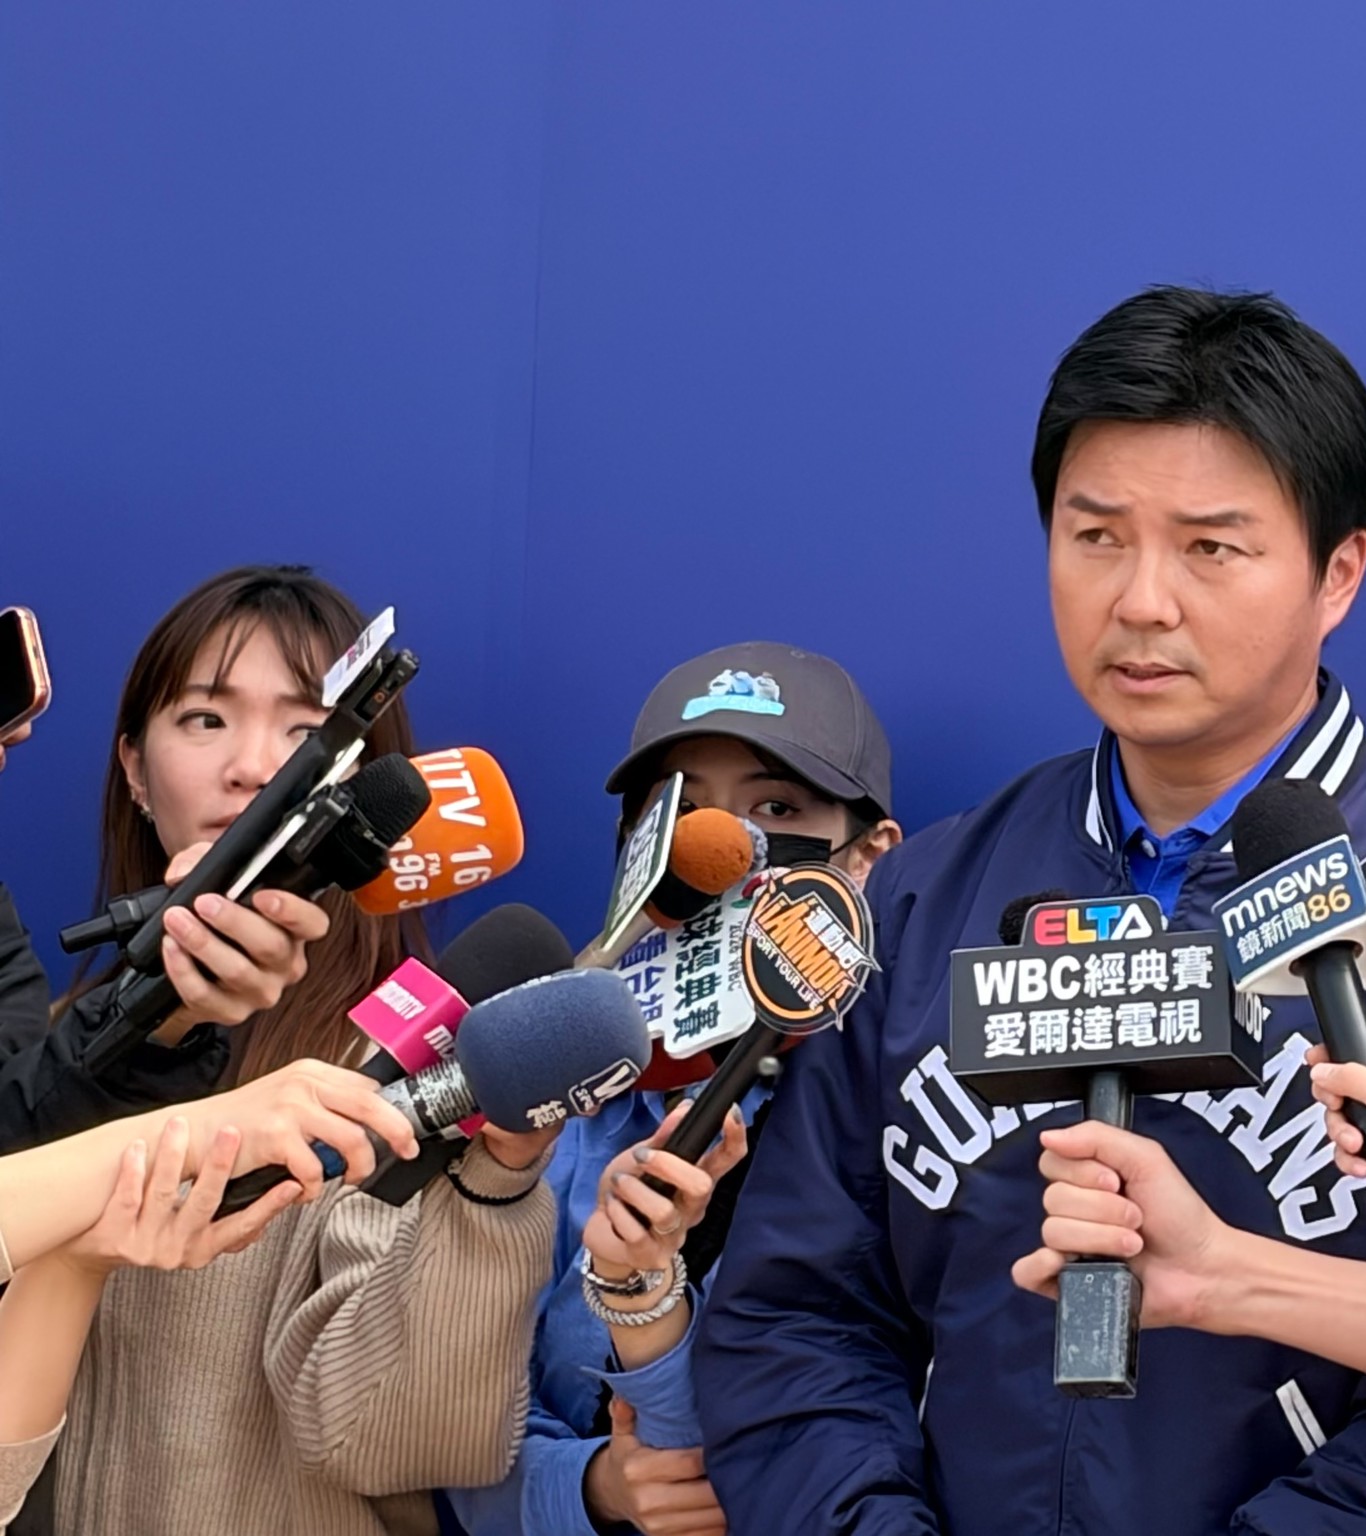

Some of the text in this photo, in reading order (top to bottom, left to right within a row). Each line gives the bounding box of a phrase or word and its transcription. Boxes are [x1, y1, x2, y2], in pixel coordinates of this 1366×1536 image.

[1033, 903, 1153, 946] ELTA
[1221, 852, 1348, 937] mnews
[673, 898, 724, 1043] 球經典賽
[746, 922, 821, 1012] SPORT YOUR LIFE
[973, 945, 1215, 1007] WBC經典賽
[983, 999, 1203, 1059] 愛爾達電視
